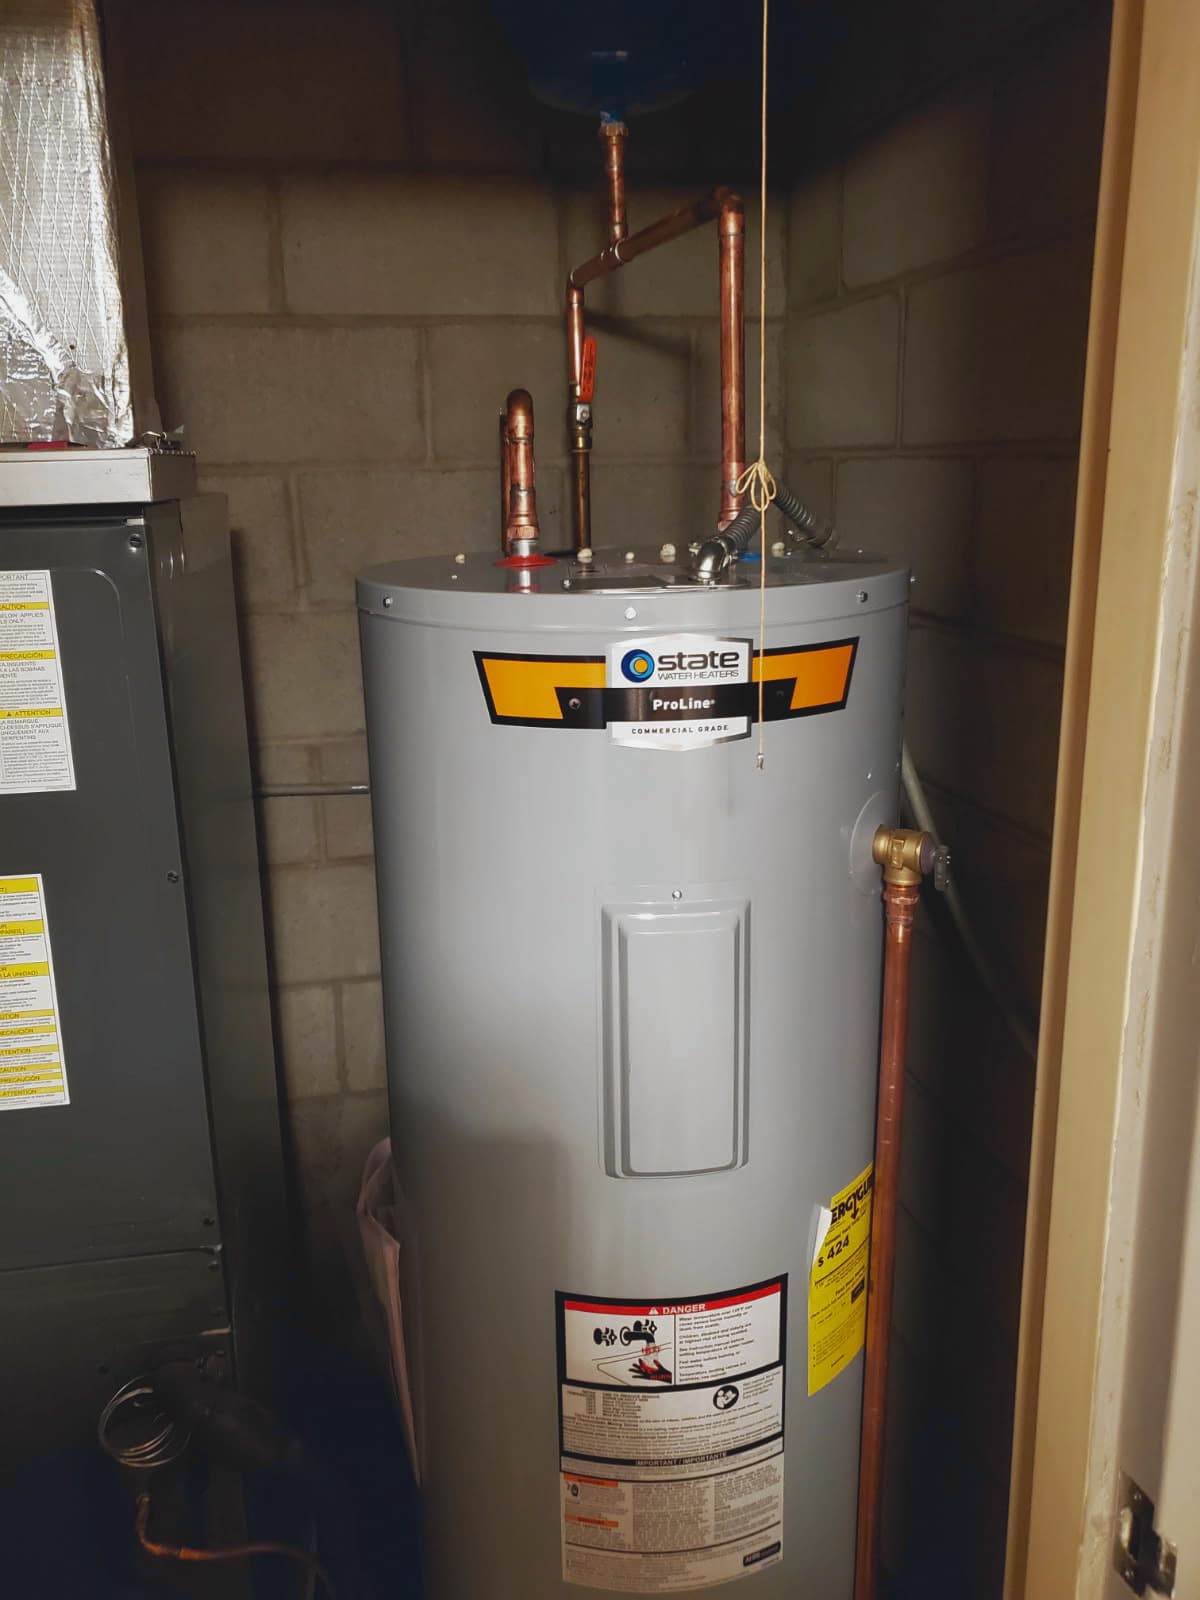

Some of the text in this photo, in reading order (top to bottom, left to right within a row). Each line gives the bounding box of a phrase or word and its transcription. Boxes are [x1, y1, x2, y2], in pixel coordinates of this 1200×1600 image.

[658, 650, 740, 671] state
[658, 670, 740, 681] WATER HEATERS
[15, 709, 51, 717] ATTENTION
[632, 724, 729, 735] COMMERCIAL GRADE
[827, 1234, 850, 1259] 424
[663, 1303, 706, 1315] DANGER
